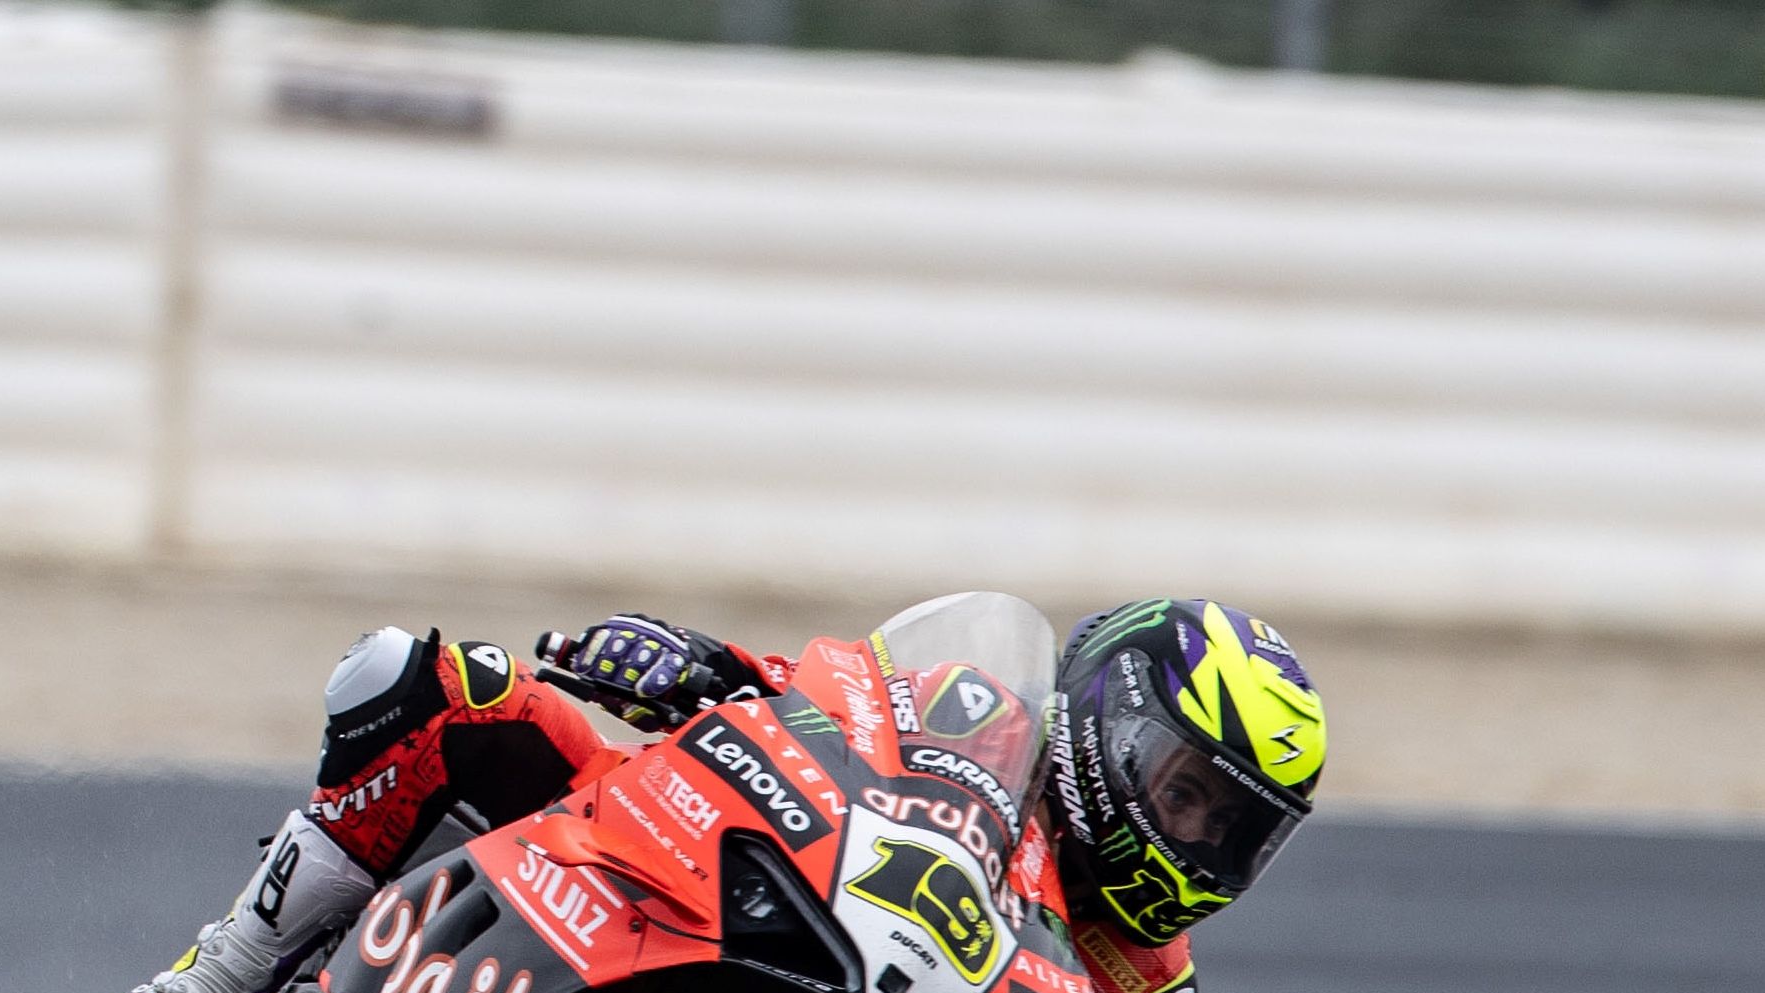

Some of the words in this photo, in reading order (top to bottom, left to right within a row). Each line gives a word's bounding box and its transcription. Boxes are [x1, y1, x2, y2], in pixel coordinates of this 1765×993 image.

[310, 765, 398, 822] EV'IT!
[695, 725, 812, 832] Lenovo
[735, 701, 850, 816] ALTEN
[1125, 801, 1186, 869] Motostorm.it
[517, 844, 610, 948] STULZ
[843, 836, 999, 985] 19
[889, 930, 938, 970] DUCATI
